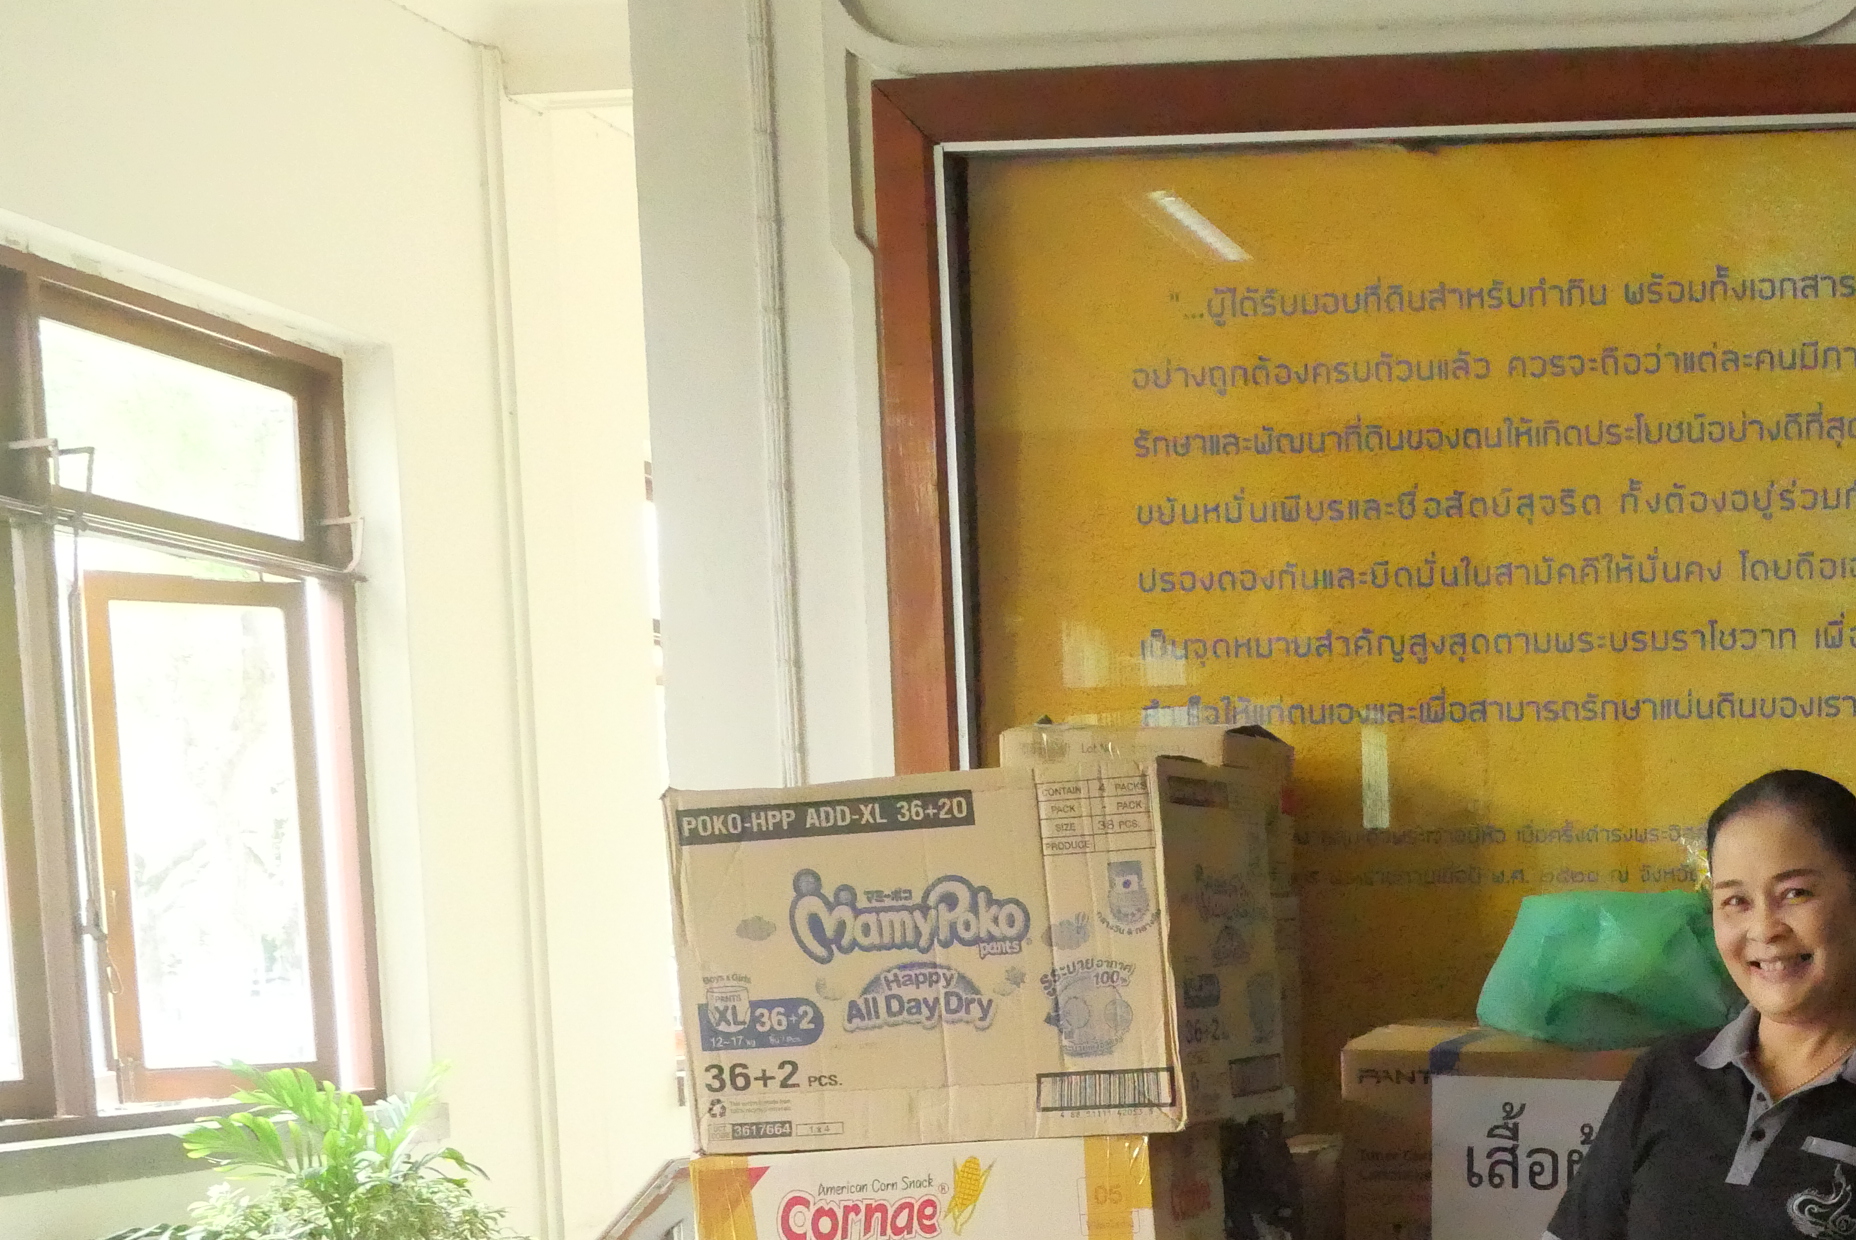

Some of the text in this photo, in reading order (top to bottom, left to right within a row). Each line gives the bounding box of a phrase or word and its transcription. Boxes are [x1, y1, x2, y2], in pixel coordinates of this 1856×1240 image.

[1114, 781, 1148, 792] PACKS
[681, 796, 967, 838] POKO-HPP ADD-XL 36+20
[979, 937, 1022, 958] pants
[883, 968, 956, 991] Happy
[713, 1004, 747, 1028] XL
[845, 989, 994, 1025] All Day Dry
[704, 1060, 843, 1093] 36+2 PCS.
[817, 1173, 934, 1197] American Corn Snack
